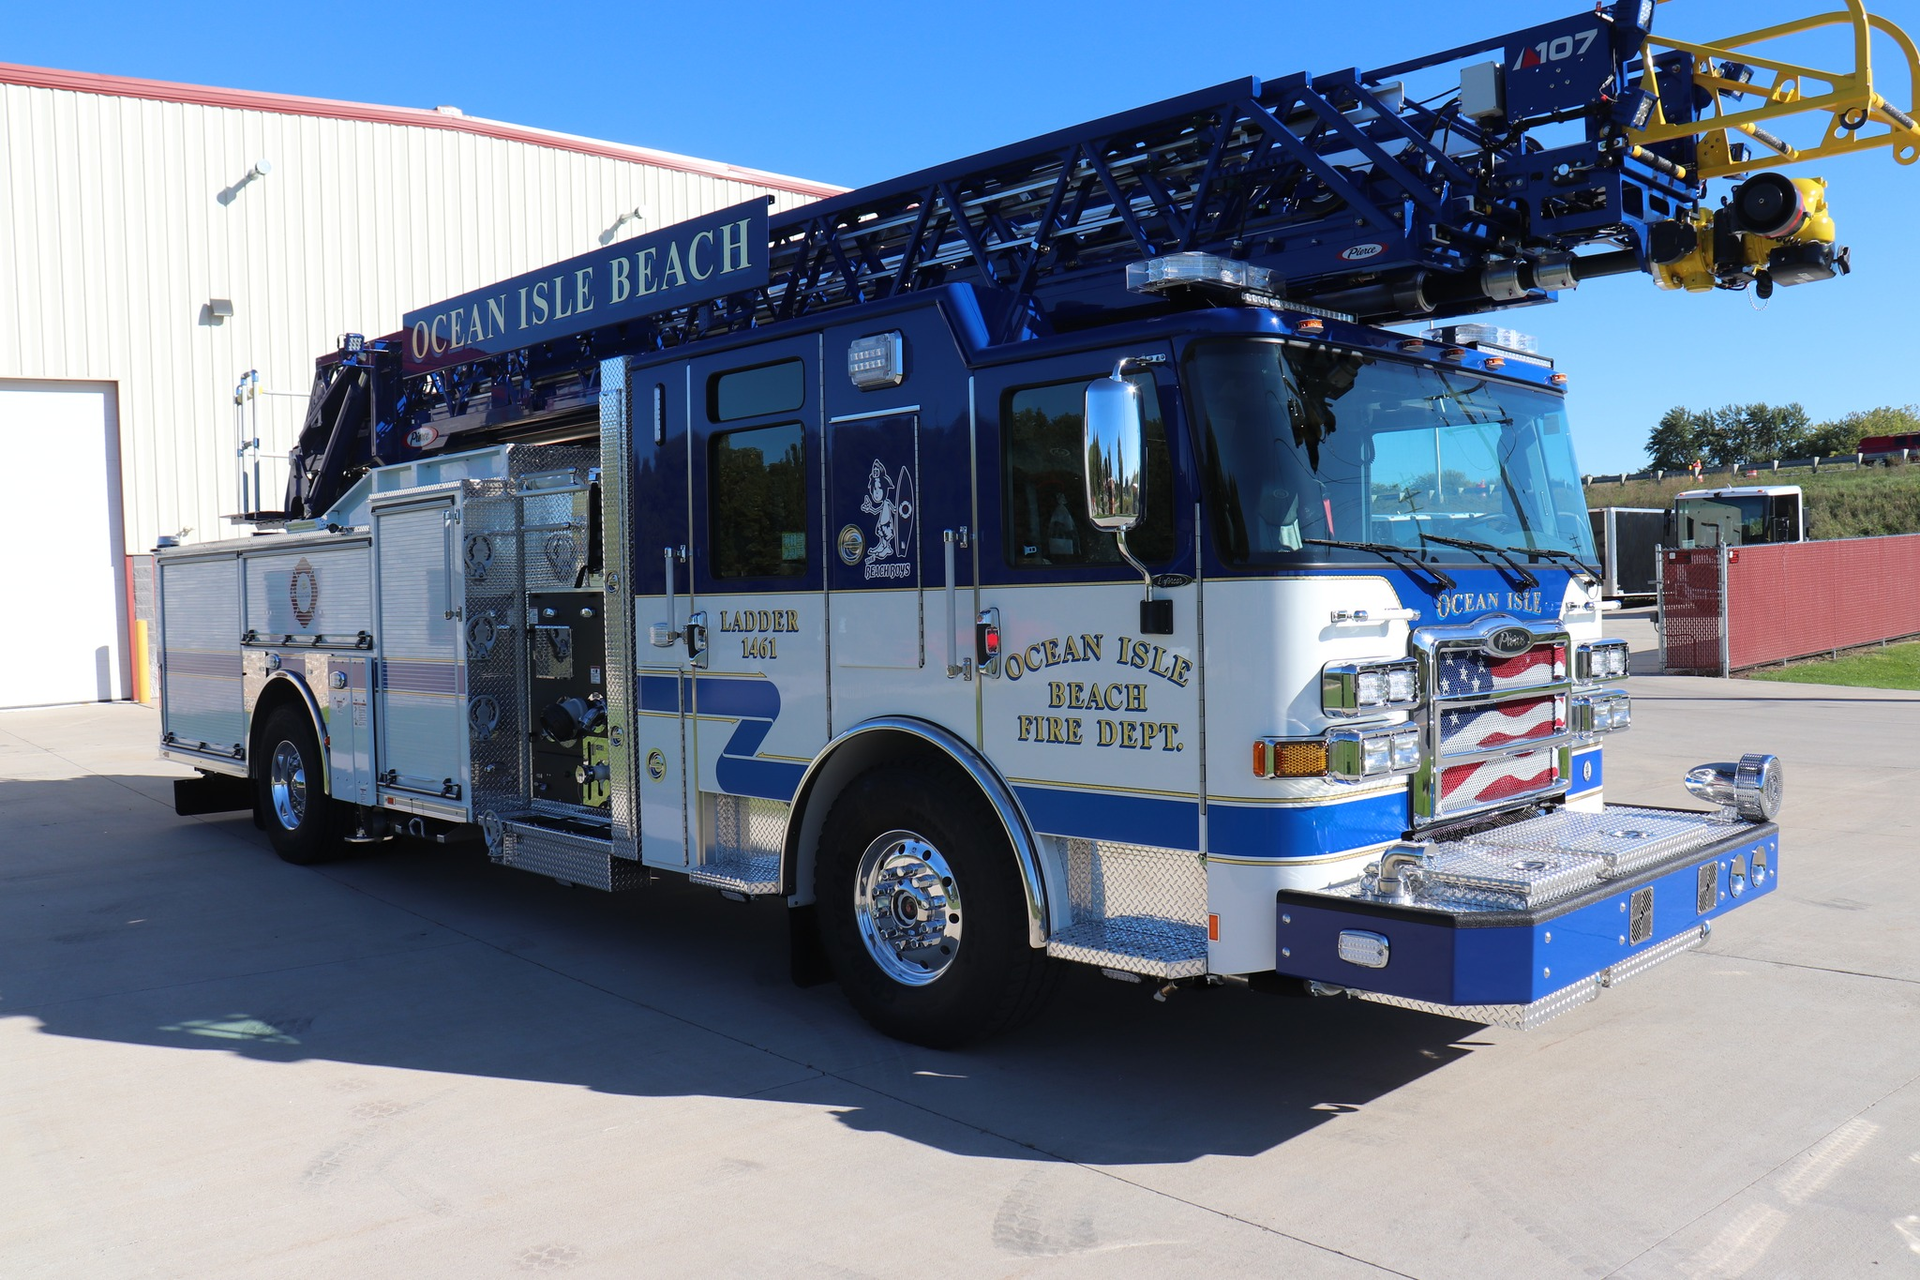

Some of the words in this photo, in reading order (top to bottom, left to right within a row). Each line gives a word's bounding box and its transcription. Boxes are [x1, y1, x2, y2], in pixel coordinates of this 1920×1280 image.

[1347, 246, 1376, 259] Pierce
[411, 294, 506, 361] OCEAN
[518, 266, 595, 330] ISLE
[609, 217, 753, 306] BEACH
[1436, 592, 1500, 620] OCEAN
[1506, 591, 1542, 616] ISLE
[720, 610, 799, 632] LADDER
[741, 636, 777, 659] 1461
[1005, 633, 1103, 681] OCEAN
[1117, 636, 1193, 687] ISLE
[1048, 681, 1148, 712] BEACH
[1017, 714, 1083, 745] FIRE
[1097, 719, 1184, 752] DEPT.
